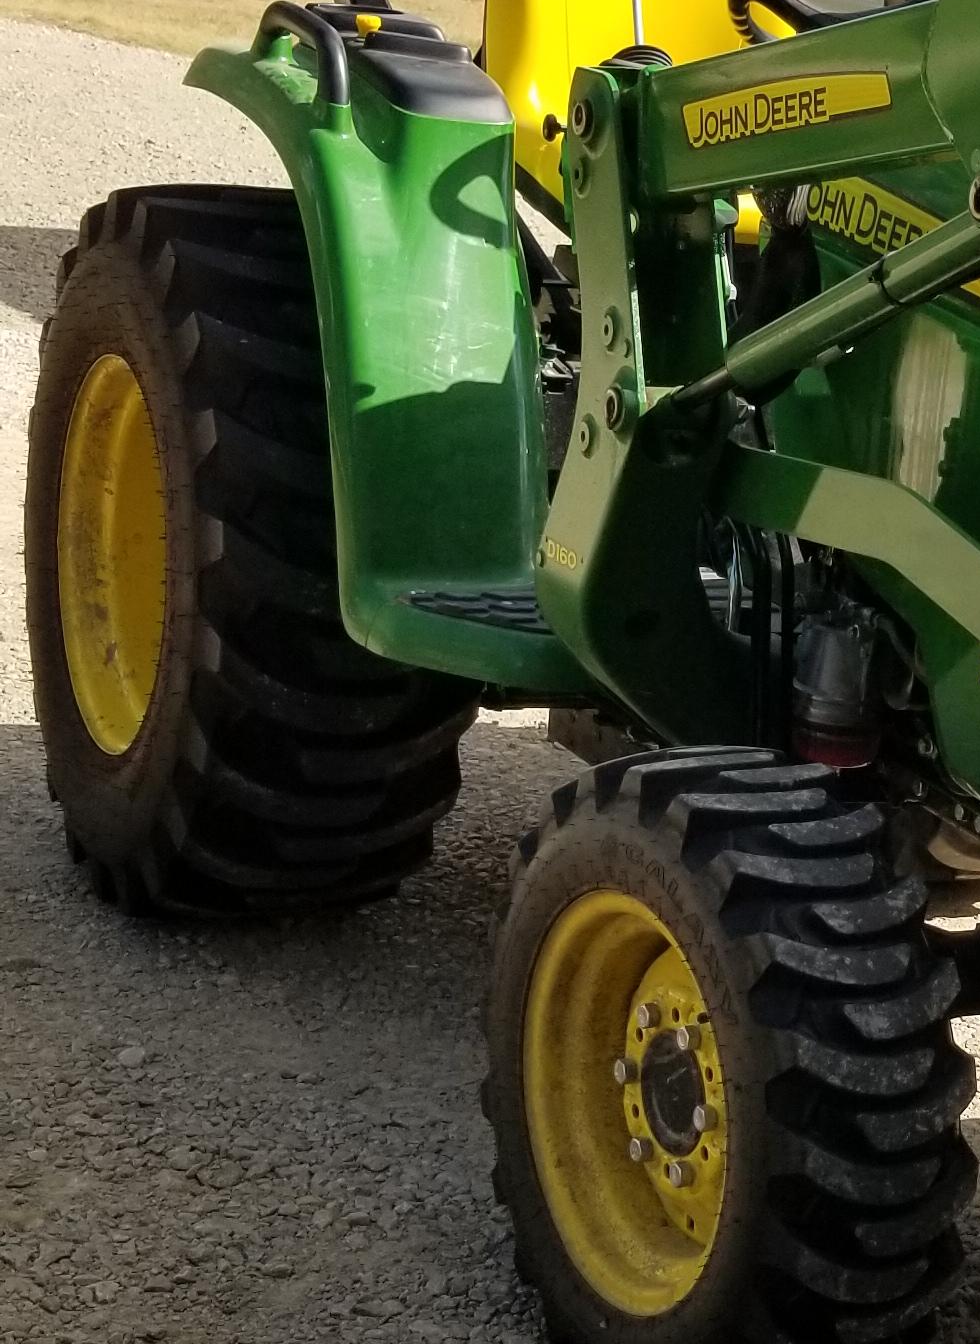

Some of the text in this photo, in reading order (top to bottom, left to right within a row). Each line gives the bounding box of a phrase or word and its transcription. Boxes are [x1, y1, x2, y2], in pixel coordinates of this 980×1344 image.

[692, 87, 827, 144] JOHN DEERE
[807, 184, 856, 231] OHN
[547, 539, 577, 570] D160
